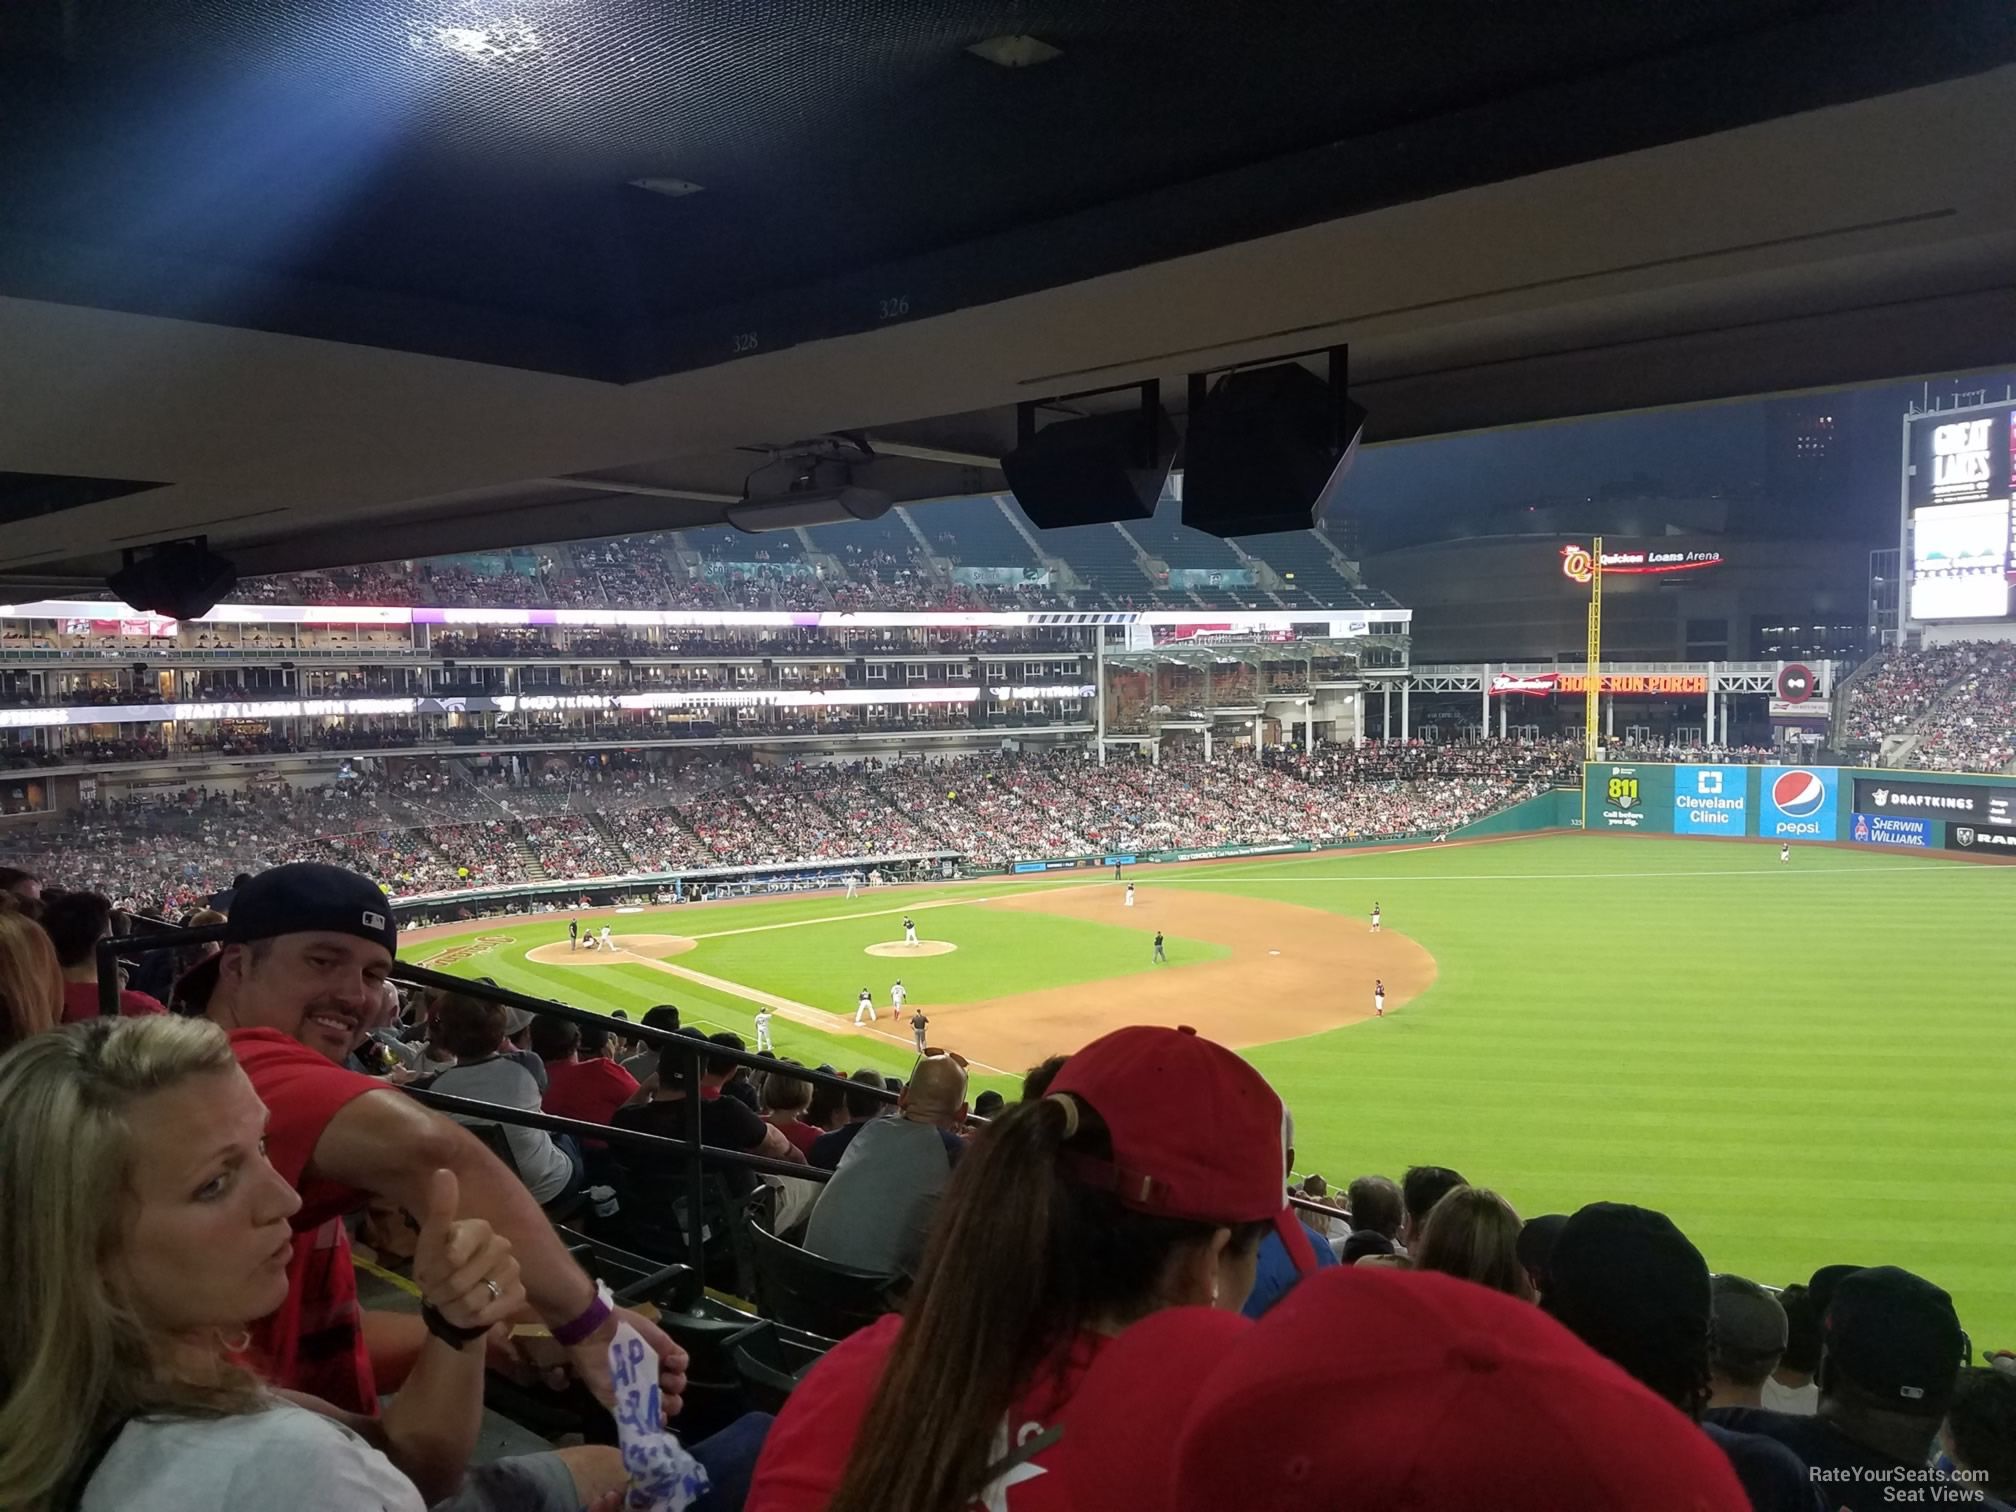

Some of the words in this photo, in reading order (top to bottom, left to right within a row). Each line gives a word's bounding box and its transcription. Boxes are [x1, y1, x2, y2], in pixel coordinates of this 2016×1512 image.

[879, 295, 910, 320] 326
[732, 331, 759, 353] 328
[1599, 553, 1644, 565] Quicken
[1648, 551, 1684, 563] Loans
[1686, 551, 1720, 561] Arena
[1611, 675, 1643, 692] RUN
[1648, 675, 1705, 693] PORCH
[1608, 778, 1638, 799] 811
[1676, 795, 1744, 809] Cleveland
[1890, 793, 1974, 810] DRAFTKINGS
[1689, 810, 1729, 824] Clinic
[1871, 816, 1924, 833] SHERWIN
[1776, 821, 1821, 835] pepsi
